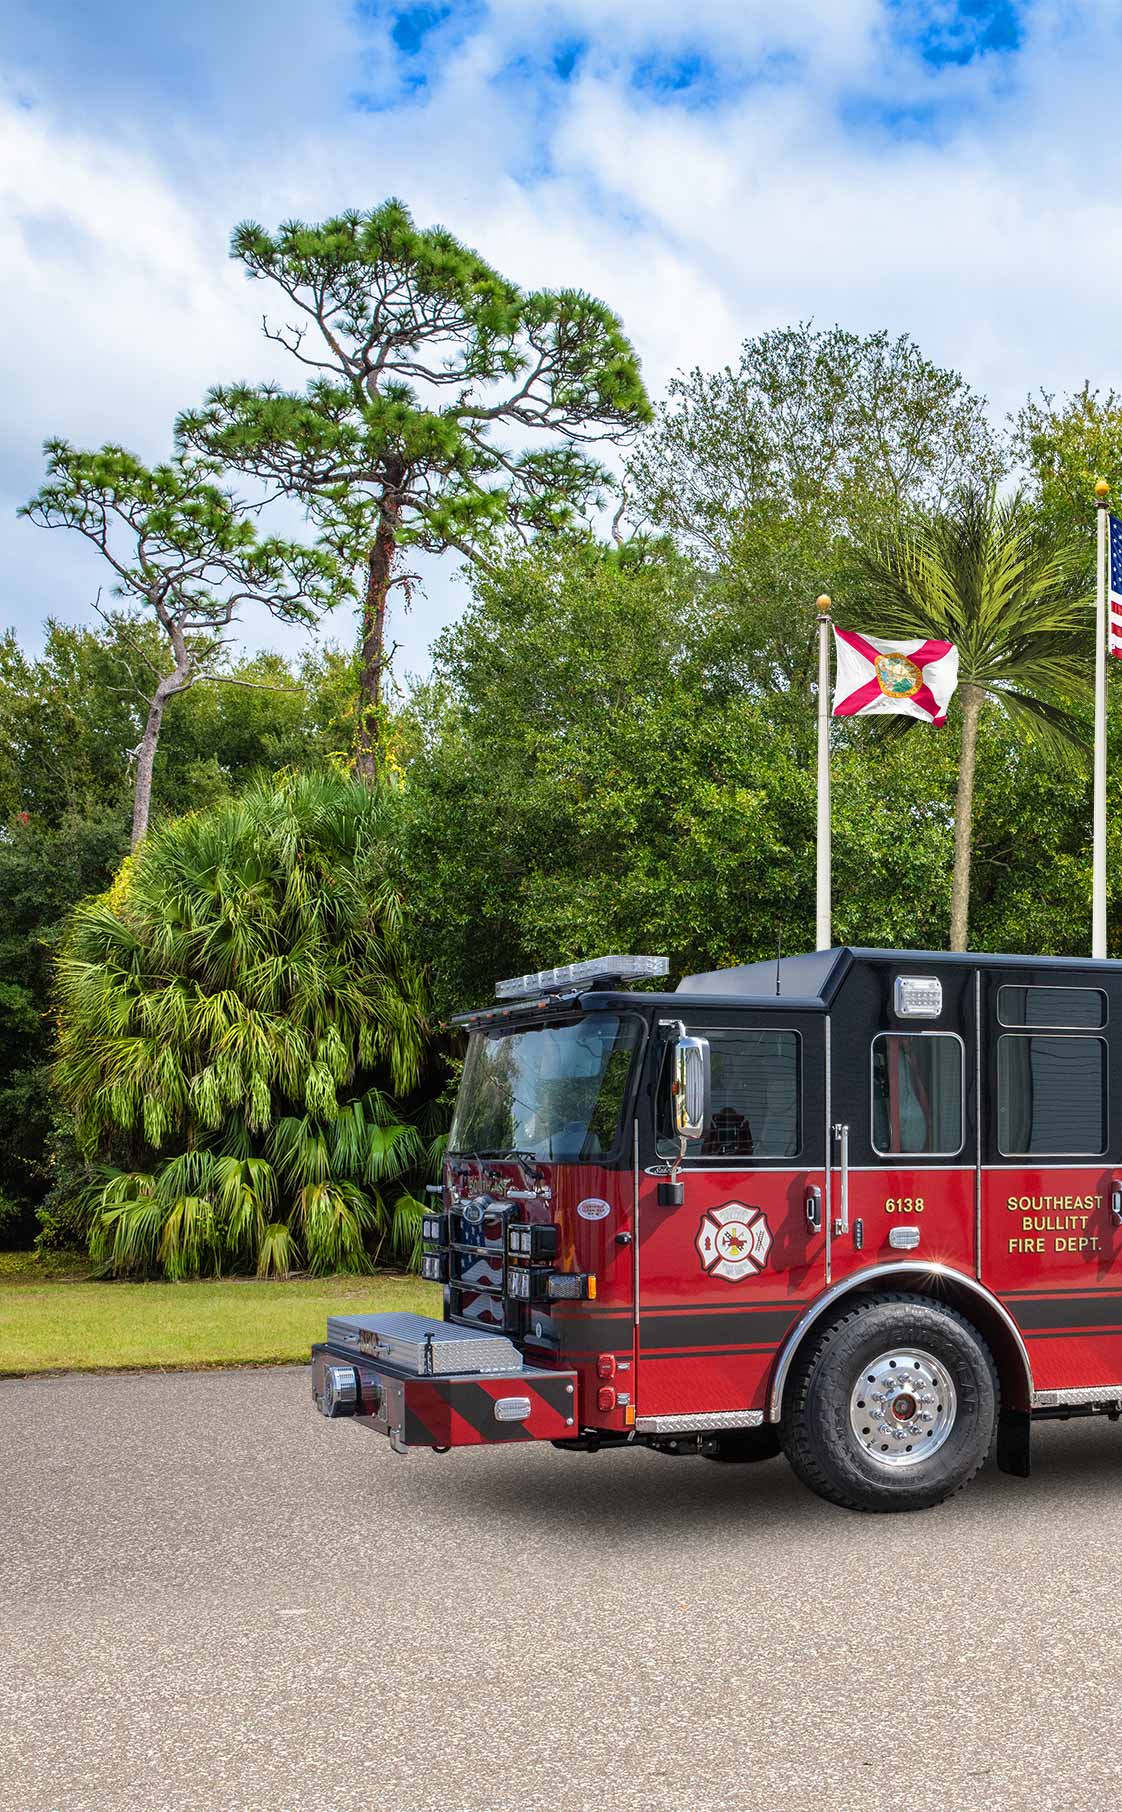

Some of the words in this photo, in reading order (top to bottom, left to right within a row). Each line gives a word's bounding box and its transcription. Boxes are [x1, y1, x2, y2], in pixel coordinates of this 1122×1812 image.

[884, 1198, 925, 1213] 6138
[1007, 1195, 1104, 1211] SOUTHEAST
[1022, 1215, 1089, 1231] BULLITT
[1008, 1238, 1046, 1253] FIRE
[1055, 1236, 1102, 1252] DEPT.
